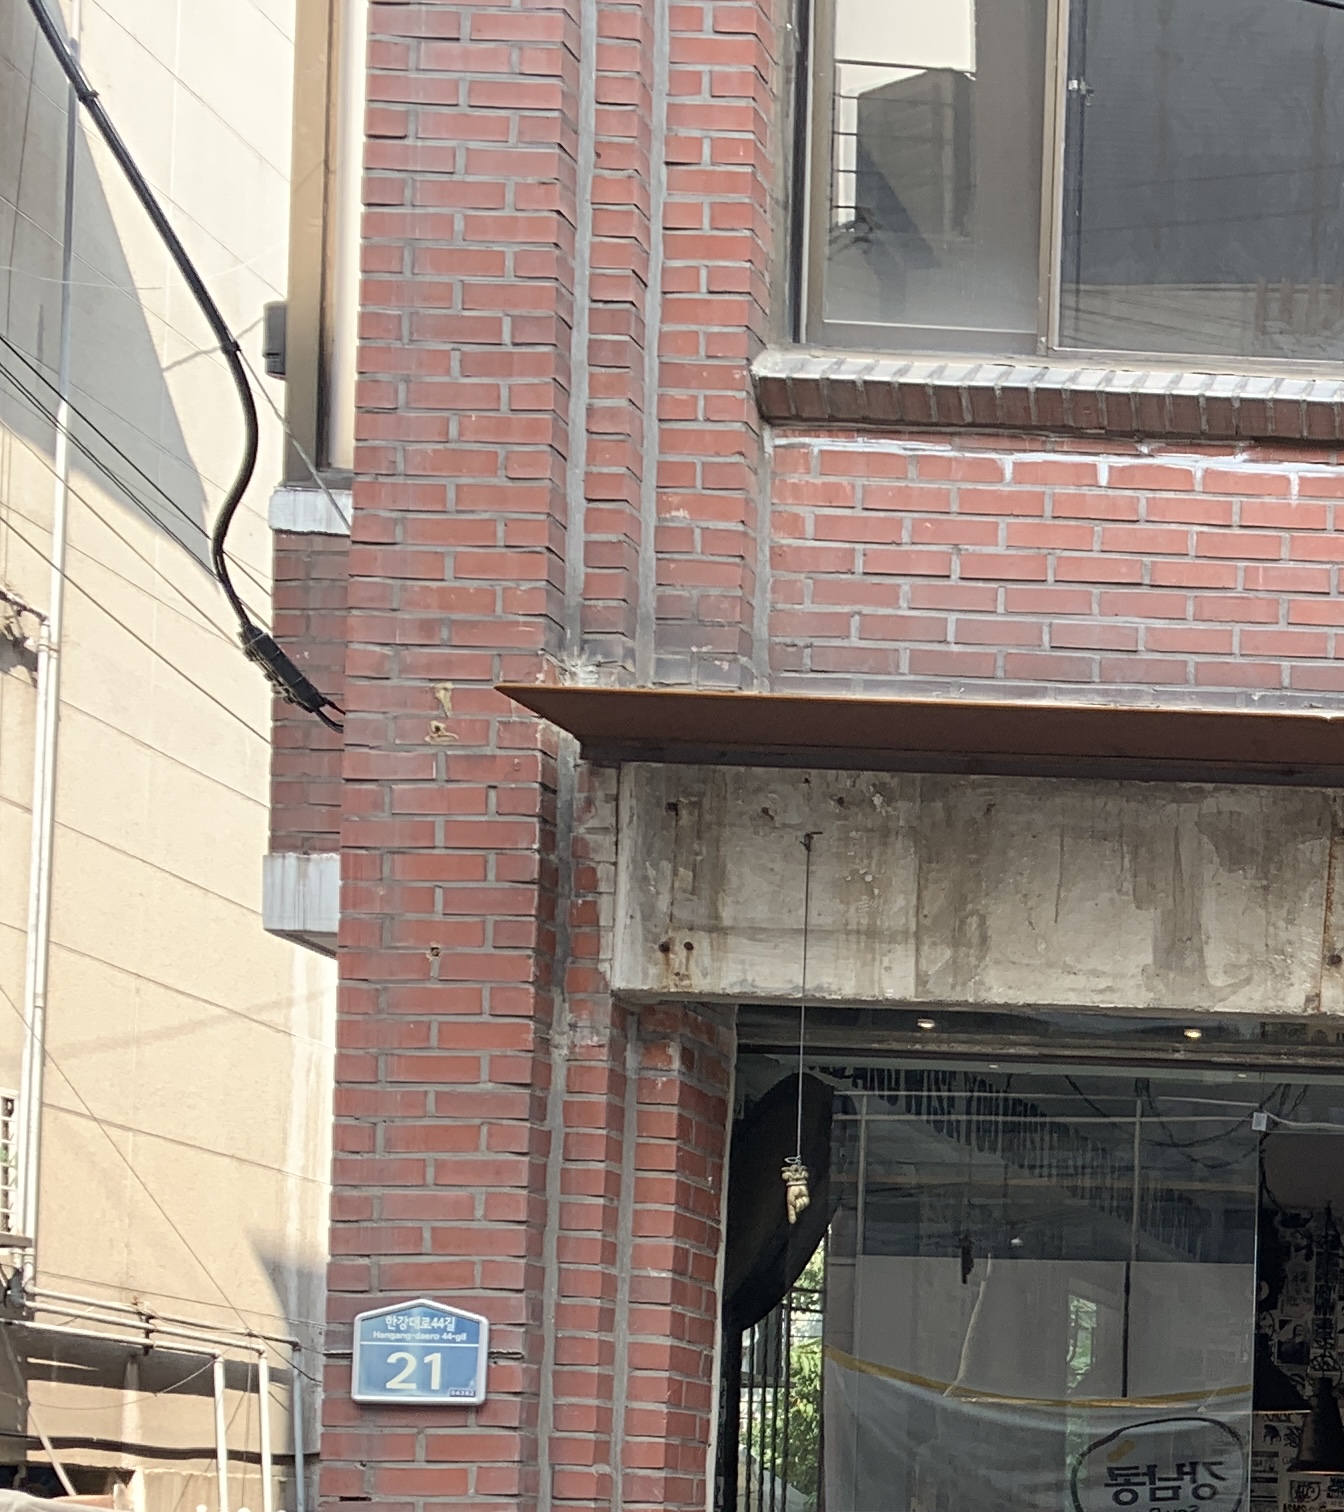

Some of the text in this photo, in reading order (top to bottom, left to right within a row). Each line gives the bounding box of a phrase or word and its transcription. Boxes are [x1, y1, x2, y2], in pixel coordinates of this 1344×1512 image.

[385, 1315, 455, 1332] 한강대로44길
[373, 1331, 467, 1342] Hangang-daero 44-gil
[385, 1352, 442, 1390] 21
